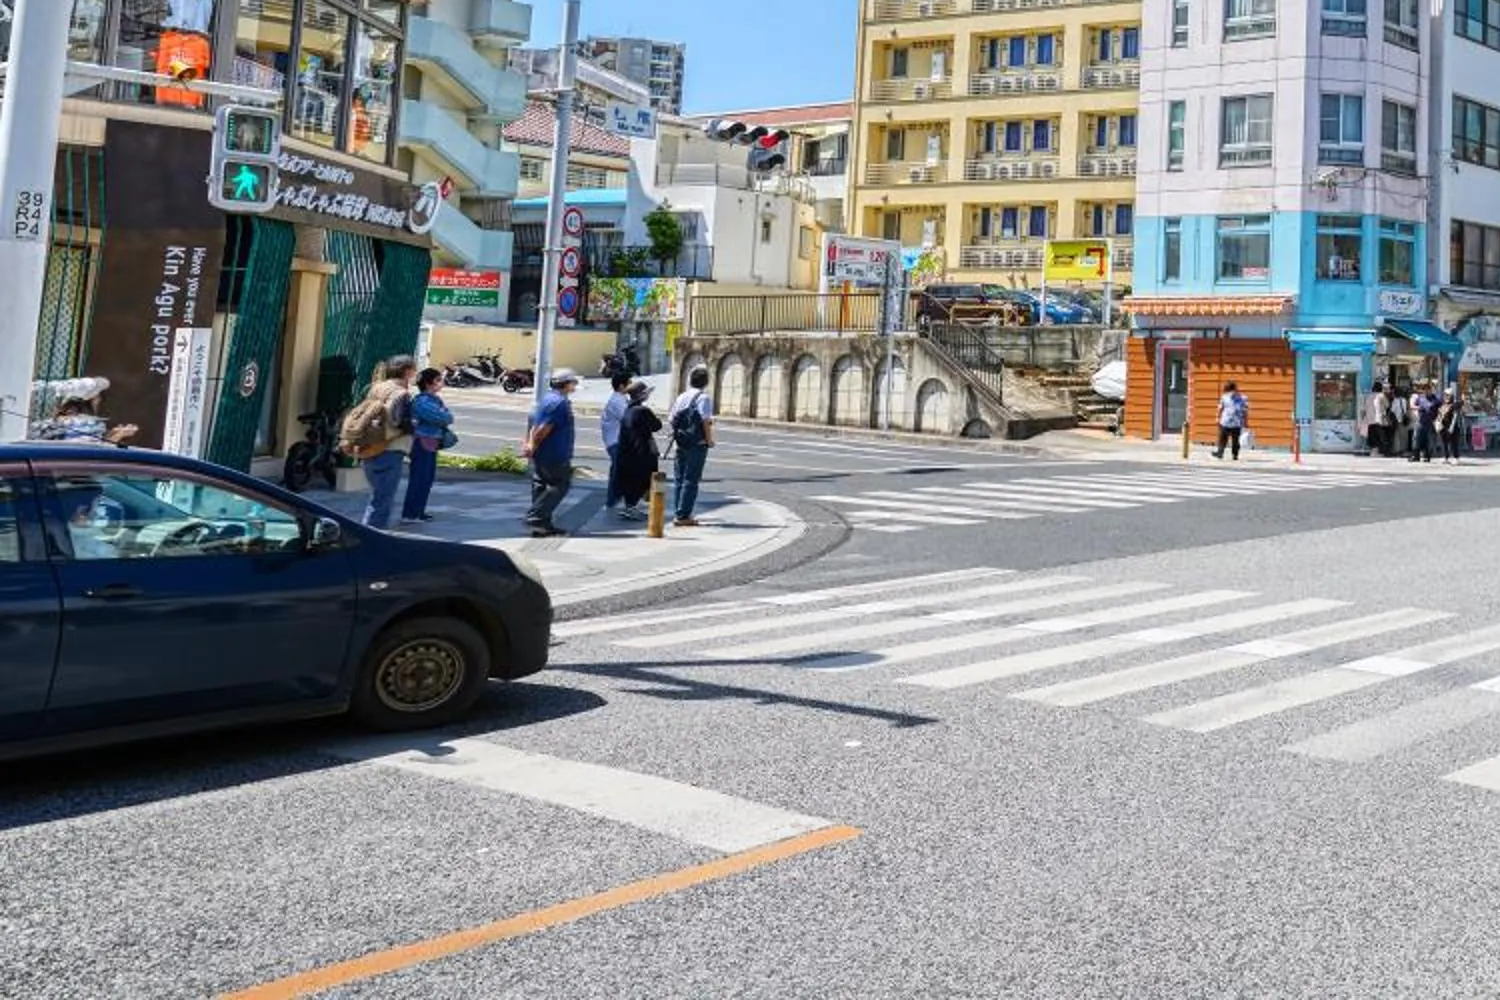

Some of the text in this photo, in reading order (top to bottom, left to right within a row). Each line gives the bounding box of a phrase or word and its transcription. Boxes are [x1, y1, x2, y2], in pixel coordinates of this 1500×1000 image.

[150, 246, 187, 376] Kin Agu pork?
[183, 247, 207, 324] Have you ever
